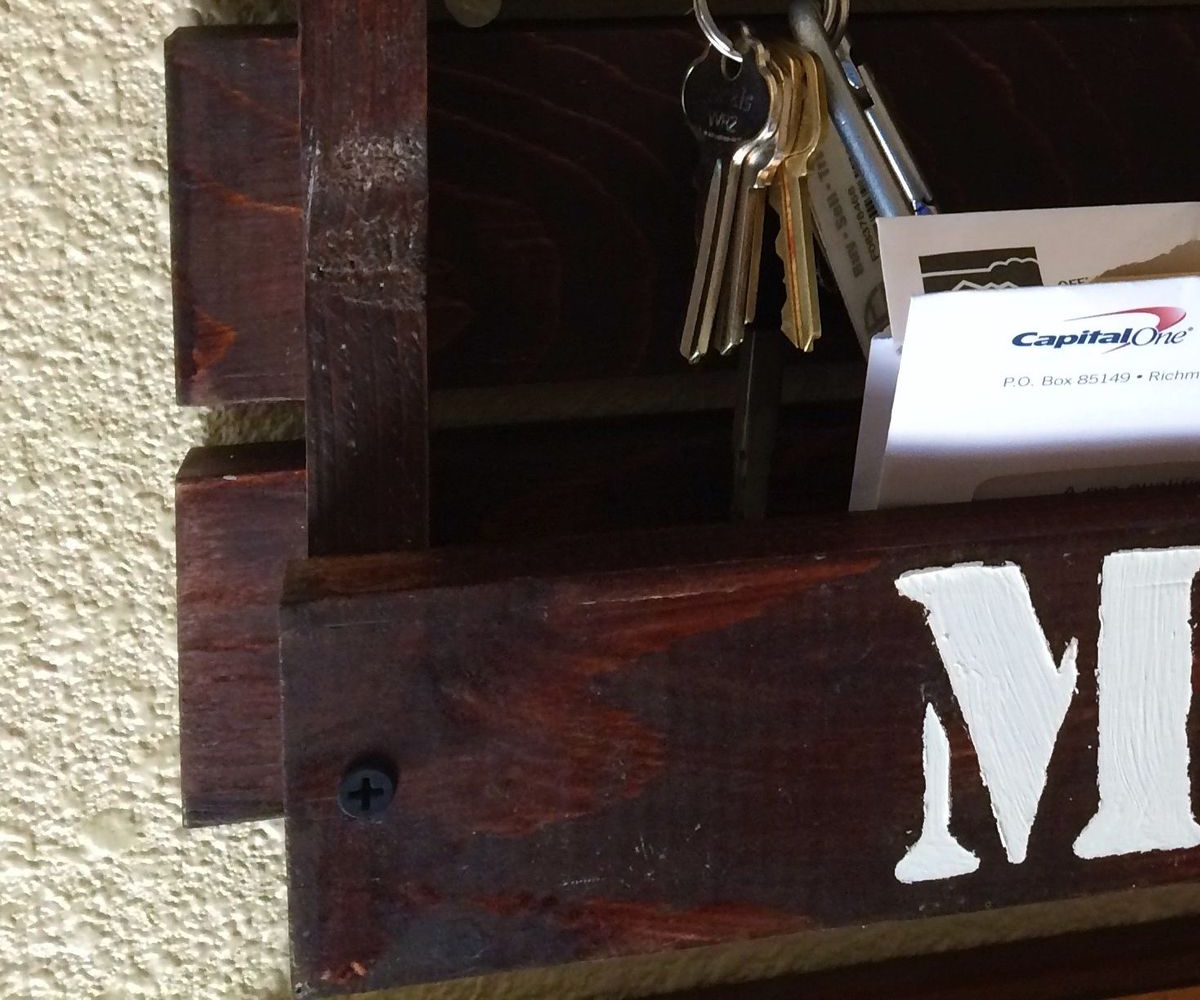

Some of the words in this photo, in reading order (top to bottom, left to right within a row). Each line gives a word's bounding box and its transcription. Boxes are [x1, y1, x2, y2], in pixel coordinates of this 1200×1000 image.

[1003, 375, 1035, 388] P.O.
[1041, 374, 1073, 387] Box
[1077, 371, 1131, 386] 85149
